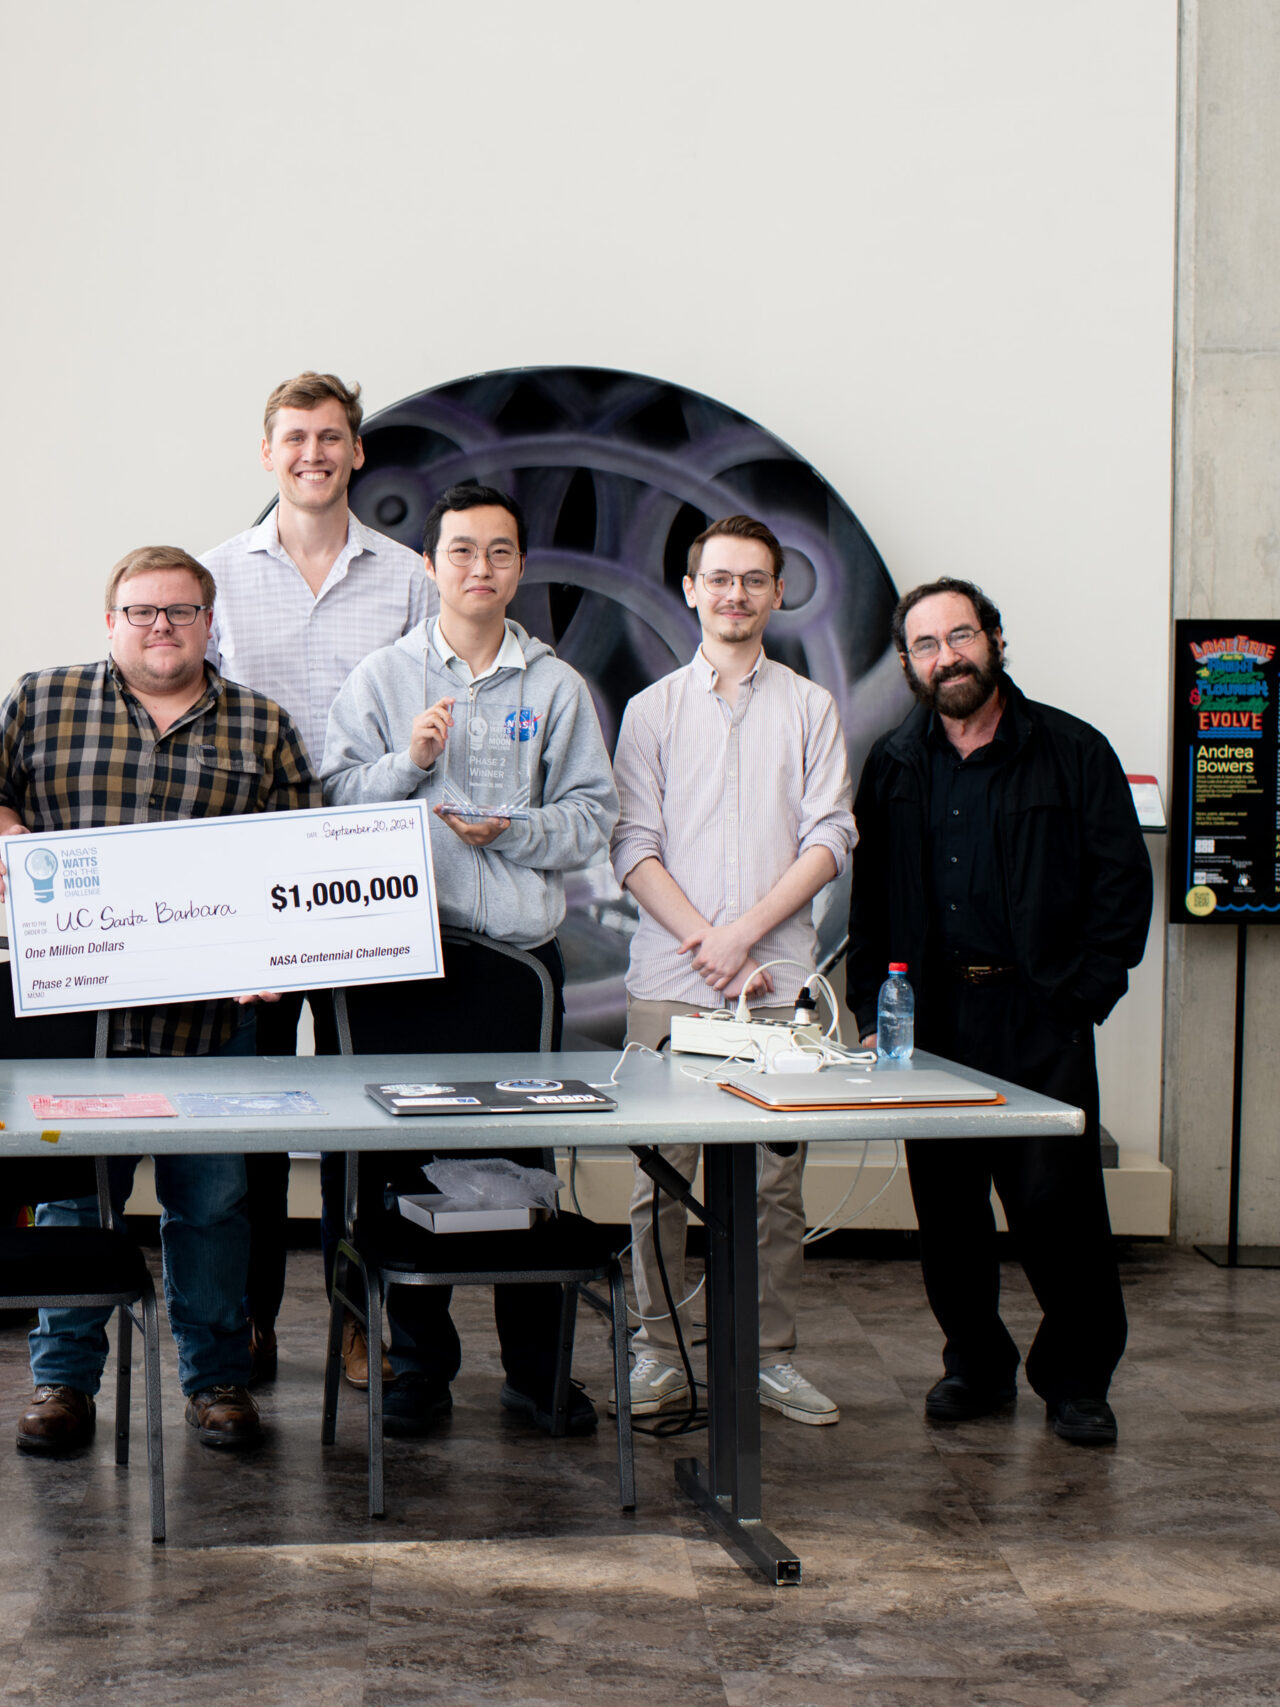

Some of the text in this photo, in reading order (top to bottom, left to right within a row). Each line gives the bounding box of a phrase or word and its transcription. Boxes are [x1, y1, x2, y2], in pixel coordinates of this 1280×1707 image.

[1189, 635, 1276, 660] LAKE ERIE
[1198, 712, 1262, 730] EVOLVE
[1197, 744, 1254, 758] Andrea
[500, 758, 506, 766] 2
[1197, 760, 1254, 773] Bowers
[322, 818, 414, 840] September 20, 2024
[61, 846, 98, 857] NASA'S
[62, 857, 98, 868] WATTS
[63, 868, 99, 877] ON THE
[64, 876, 100, 889] MOON
[64, 888, 101, 897] CHALLENGE
[271, 874, 418, 912] $1,000,000
[56, 900, 236, 932] UC Santa Barbara
[25, 941, 124, 959] One Million Dollars
[270, 946, 410, 966] NASA Centennial Challenges
[32, 974, 109, 990] Phase 2 Winner
